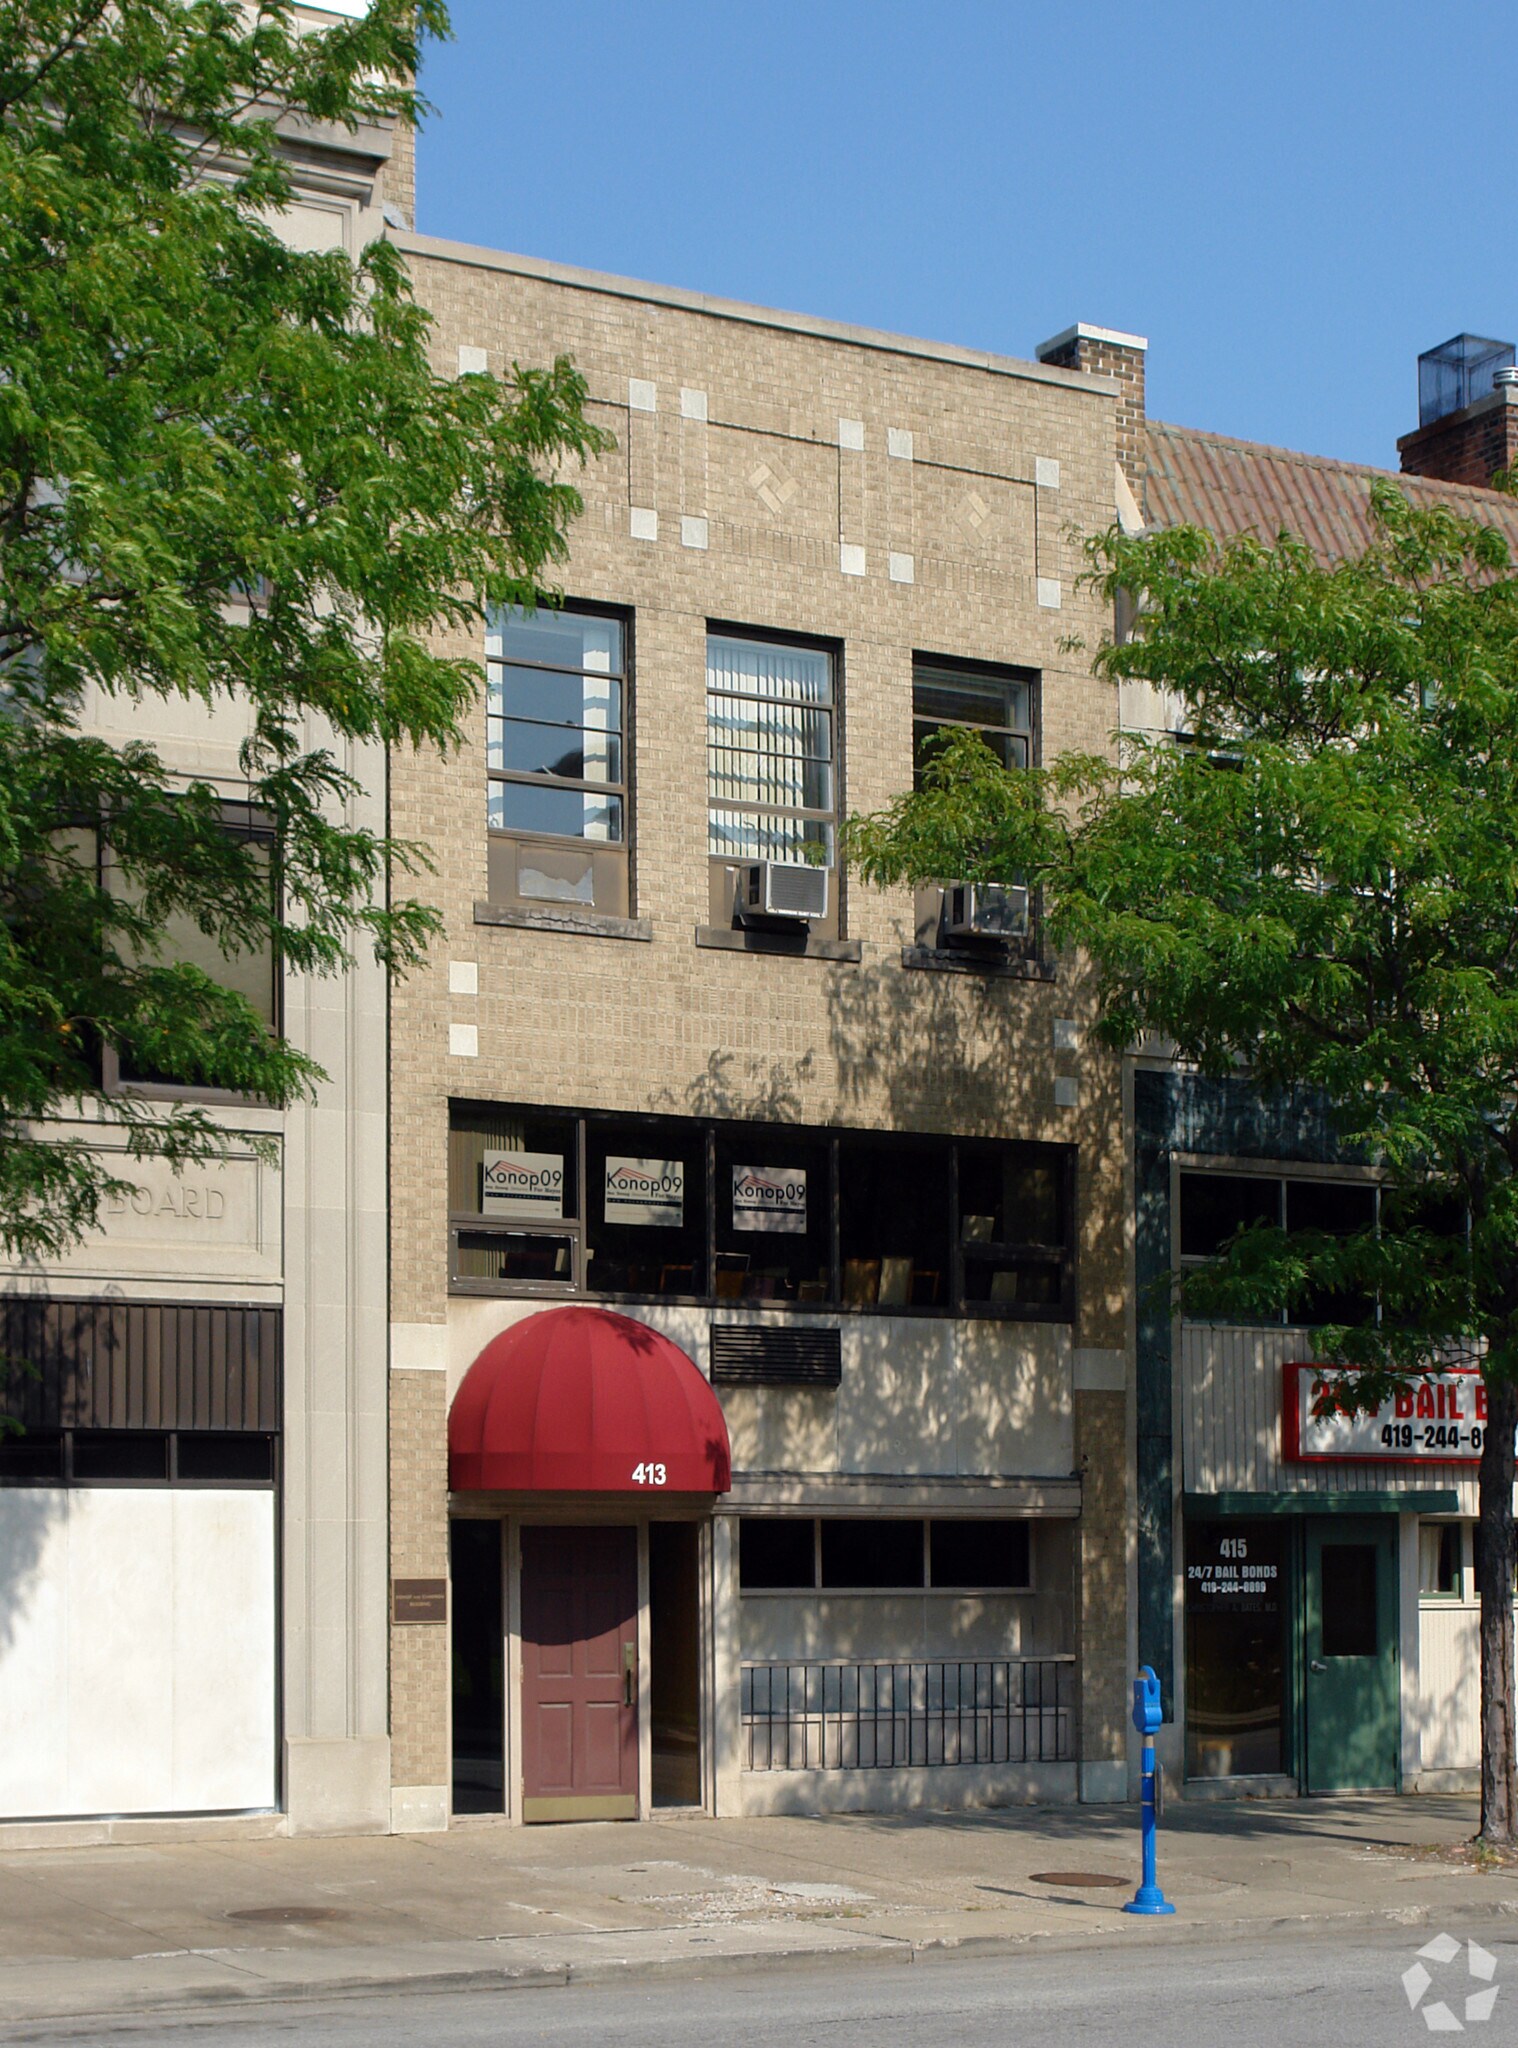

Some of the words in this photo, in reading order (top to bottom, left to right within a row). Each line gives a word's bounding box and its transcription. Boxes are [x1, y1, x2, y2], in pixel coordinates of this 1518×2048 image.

[485, 1161, 562, 1192] Konop09
[607, 1168, 682, 1198] Konop09
[734, 1176, 806, 1205] Konop09
[1394, 1382, 1464, 1420] BAIL
[1381, 1424, 1485, 1450] 419-244-8
[632, 1463, 667, 1485] 413
[1219, 1538, 1247, 1558] 415
[1188, 1565, 1213, 1579] 24/7
[1215, 1565, 1239, 1578] BAIL
[1241, 1565, 1278, 1578] BONDS
